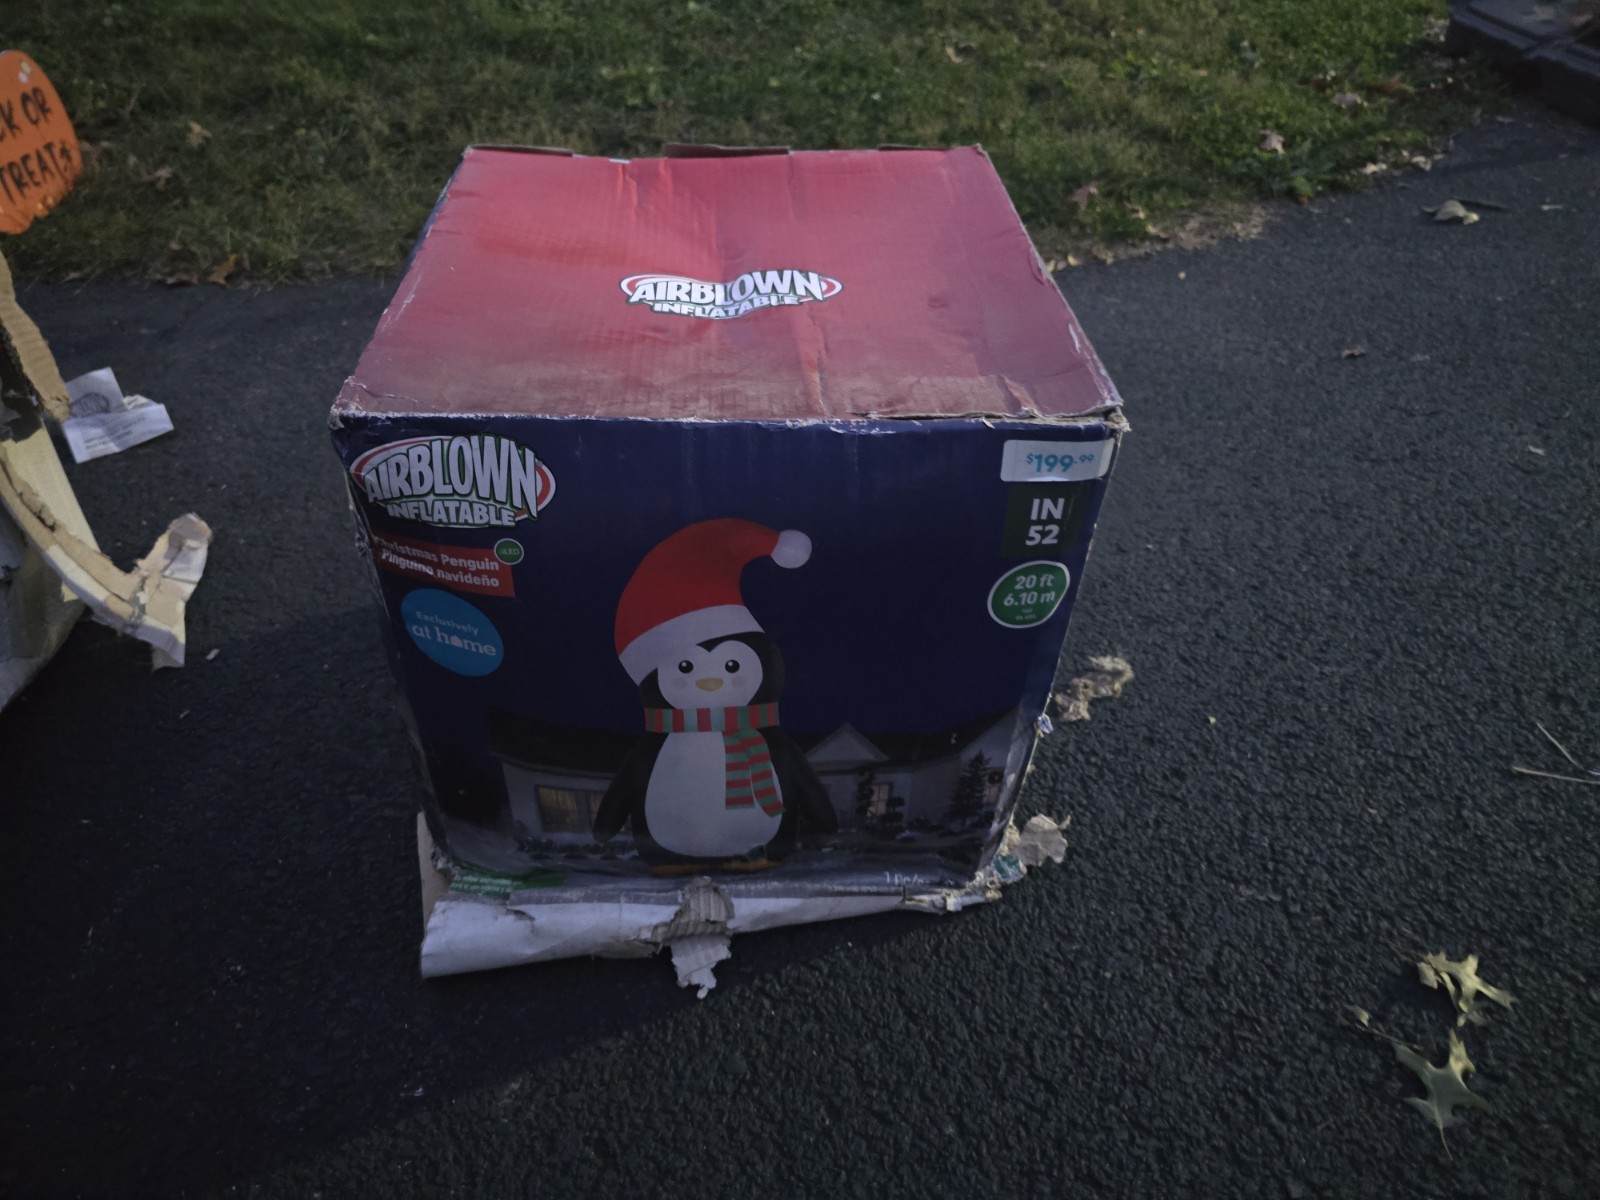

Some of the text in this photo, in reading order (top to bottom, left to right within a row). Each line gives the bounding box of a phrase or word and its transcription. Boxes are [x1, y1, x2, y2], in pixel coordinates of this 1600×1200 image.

[0, 87, 52, 141] K OR
[629, 270, 824, 306] AIRBLOWN
[652, 295, 800, 318] INFLATABLE
[1026, 453, 1095, 473] $199.99
[362, 434, 539, 519] AIRBLOWN
[386, 499, 517, 527] INFLATABLE
[1030, 497, 1066, 521] IN
[1025, 524, 1060, 546] 52
[381, 542, 500, 571] ristmas Penguin
[437, 568, 500, 588] navideño
[1014, 573, 1055, 590] 20 ft
[1004, 591, 1039, 607] 6.10
[412, 624, 432, 640] at
[415, 610, 479, 636] Exclusively
